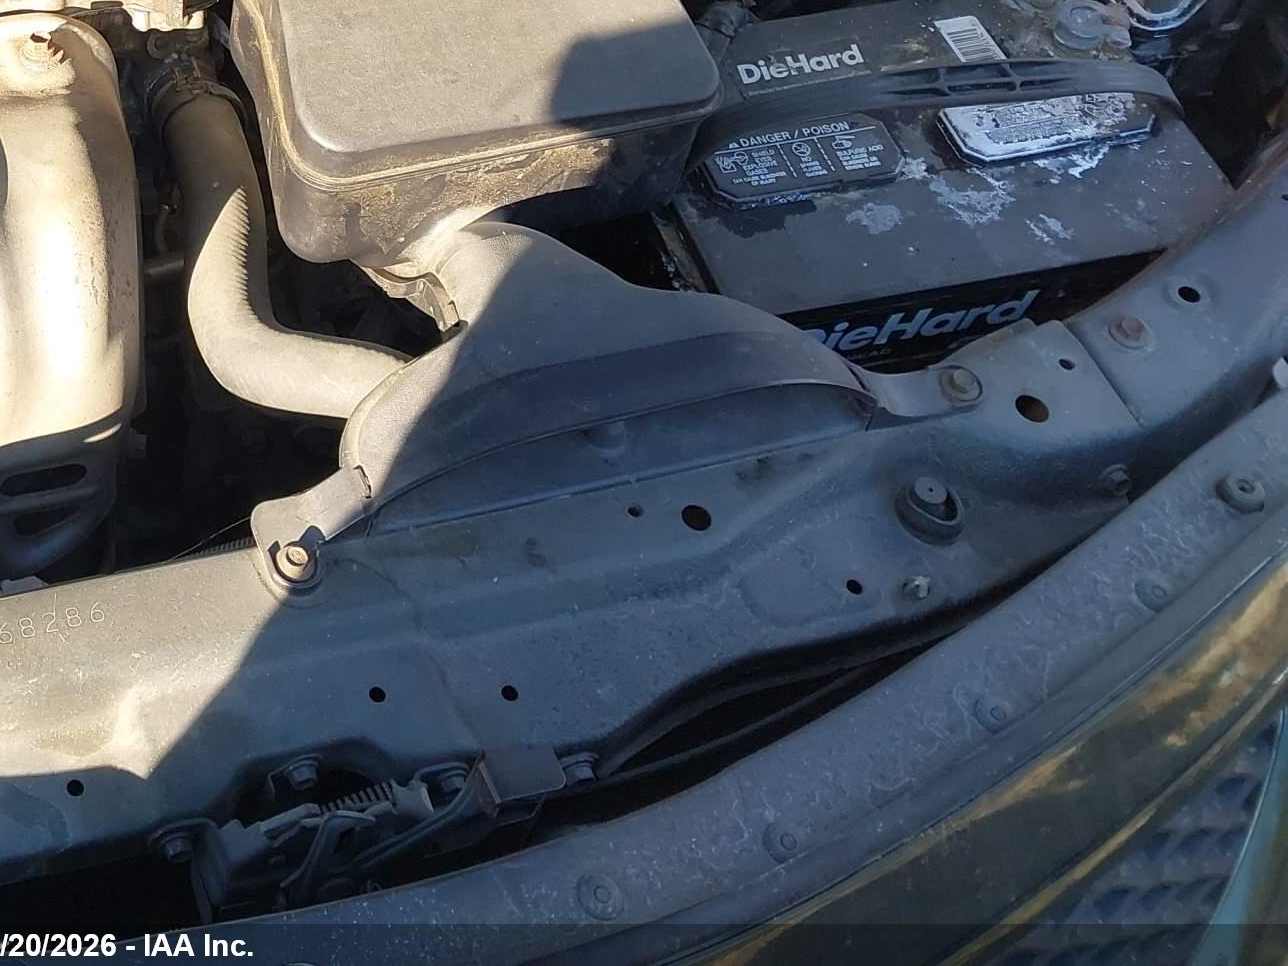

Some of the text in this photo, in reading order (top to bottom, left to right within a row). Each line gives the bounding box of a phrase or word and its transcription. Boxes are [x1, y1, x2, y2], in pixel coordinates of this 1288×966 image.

[736, 44, 865, 85] DieHard
[739, 131, 790, 148] DANGER
[802, 122, 851, 137] POISON
